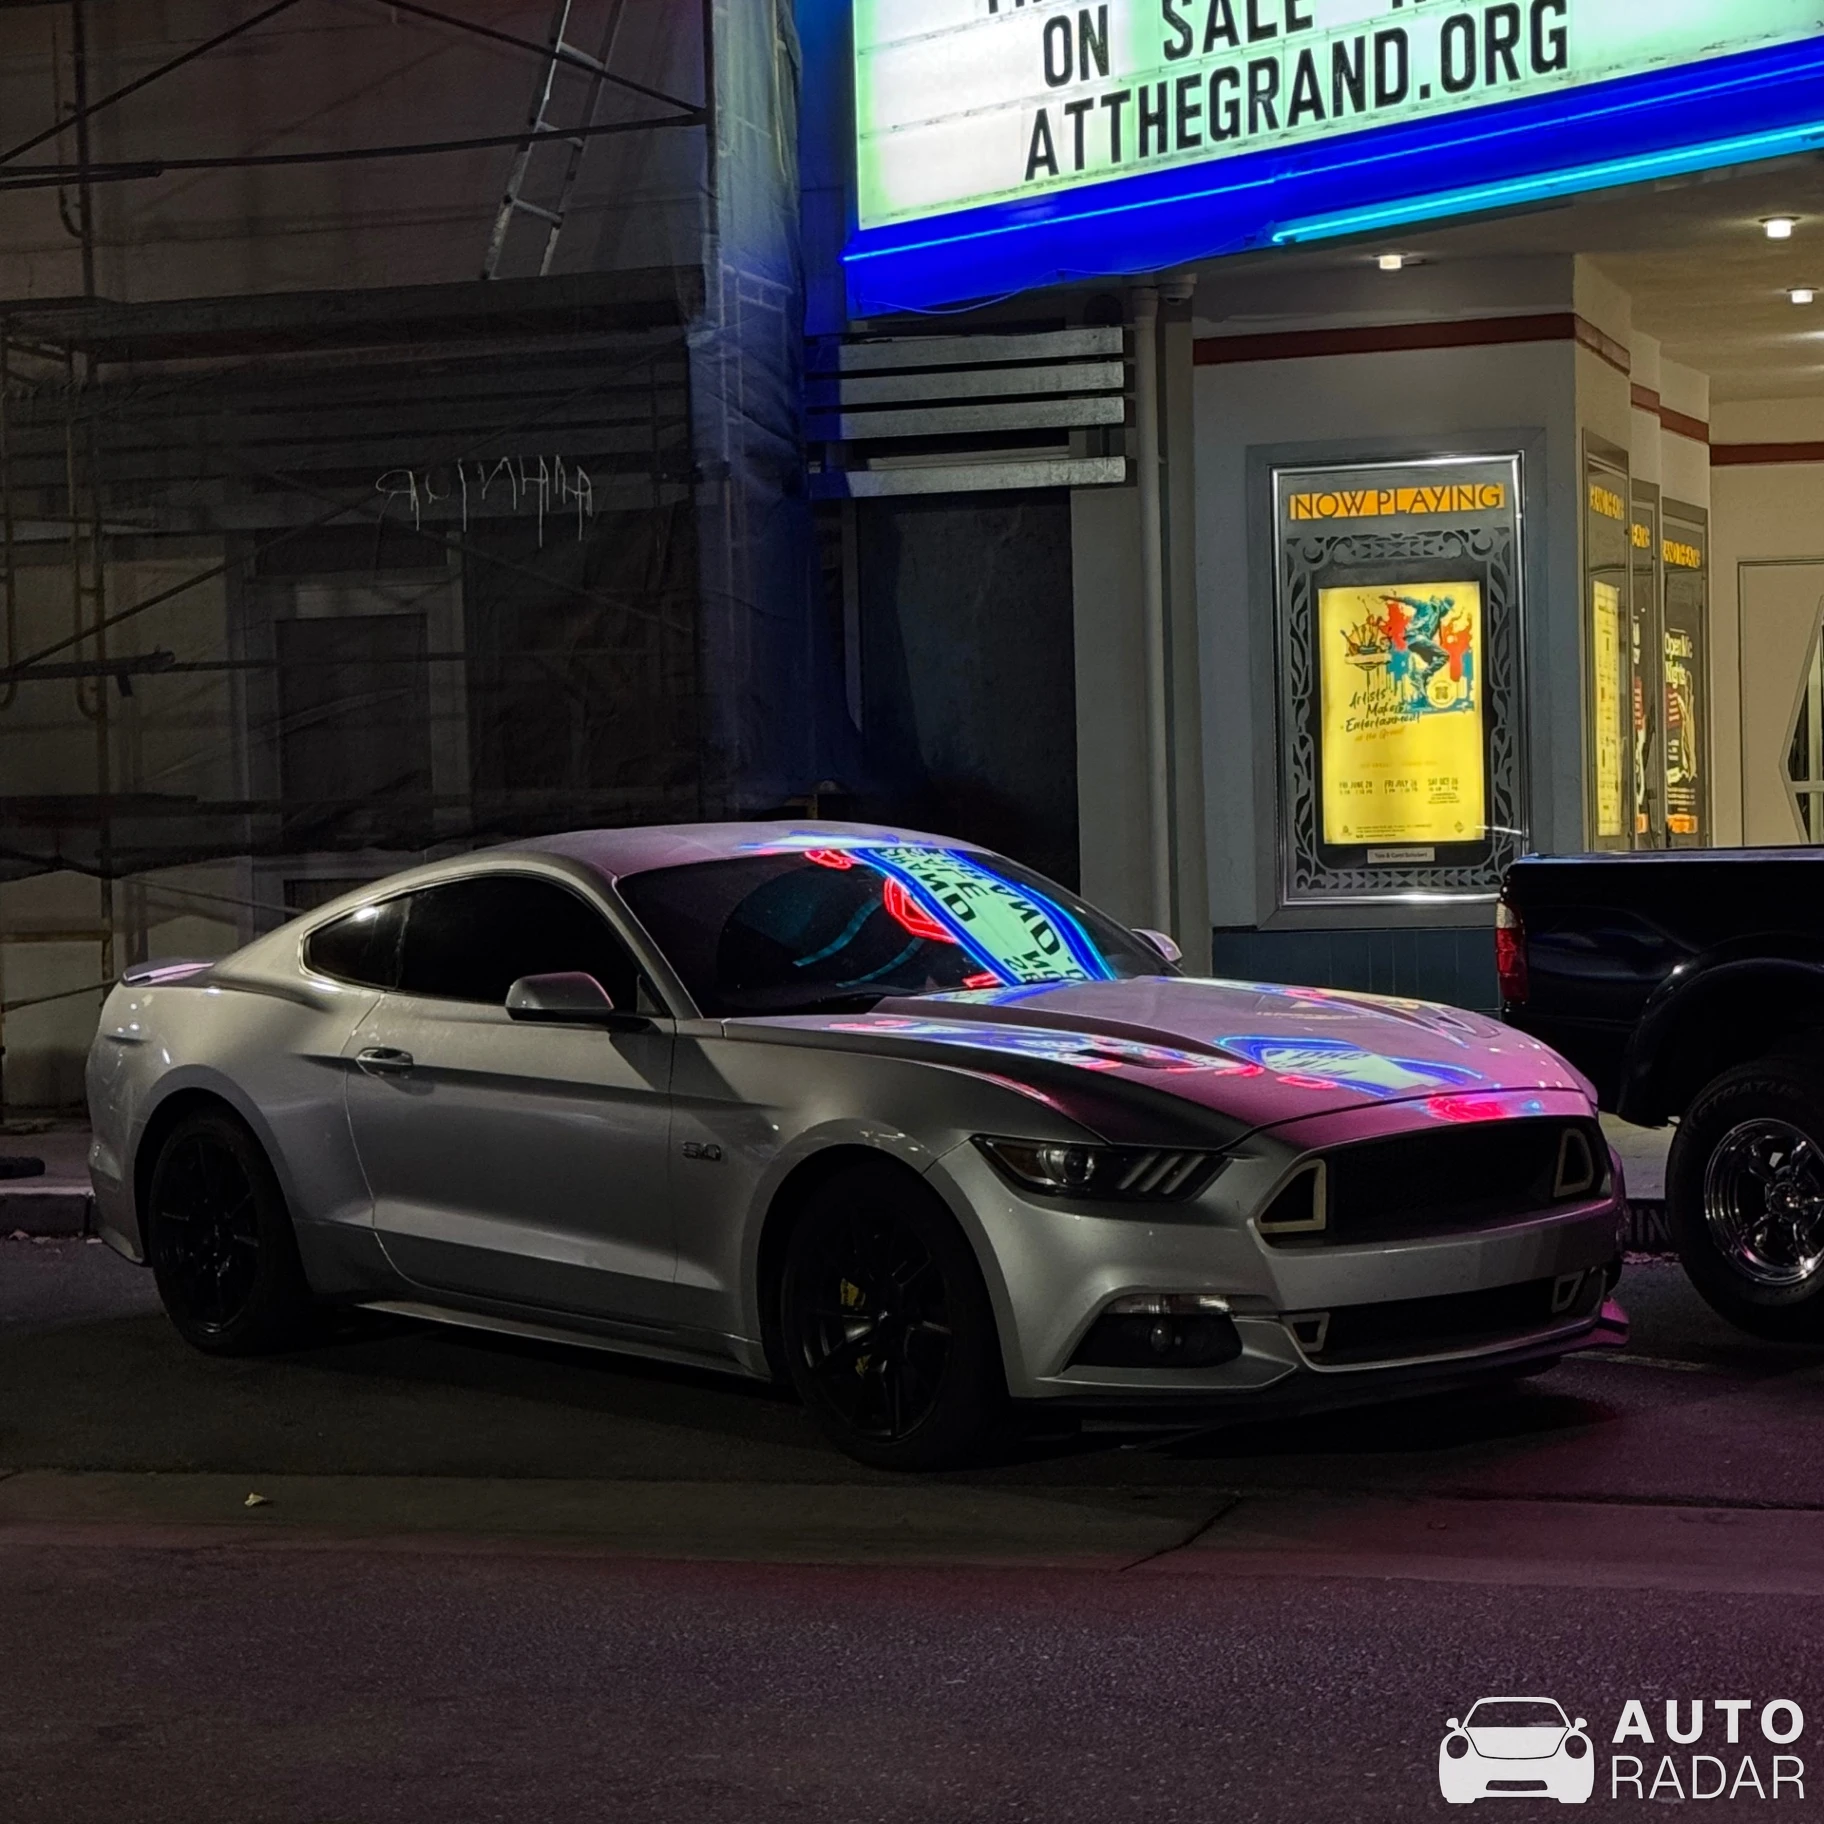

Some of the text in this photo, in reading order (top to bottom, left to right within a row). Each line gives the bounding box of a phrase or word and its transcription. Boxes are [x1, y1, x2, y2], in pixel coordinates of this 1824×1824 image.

[1043, 5, 1110, 88] ON
[1024, 0, 1568, 181] ATTHEGRAND.ORG
[1294, 484, 1501, 519] NOW PLAYING
